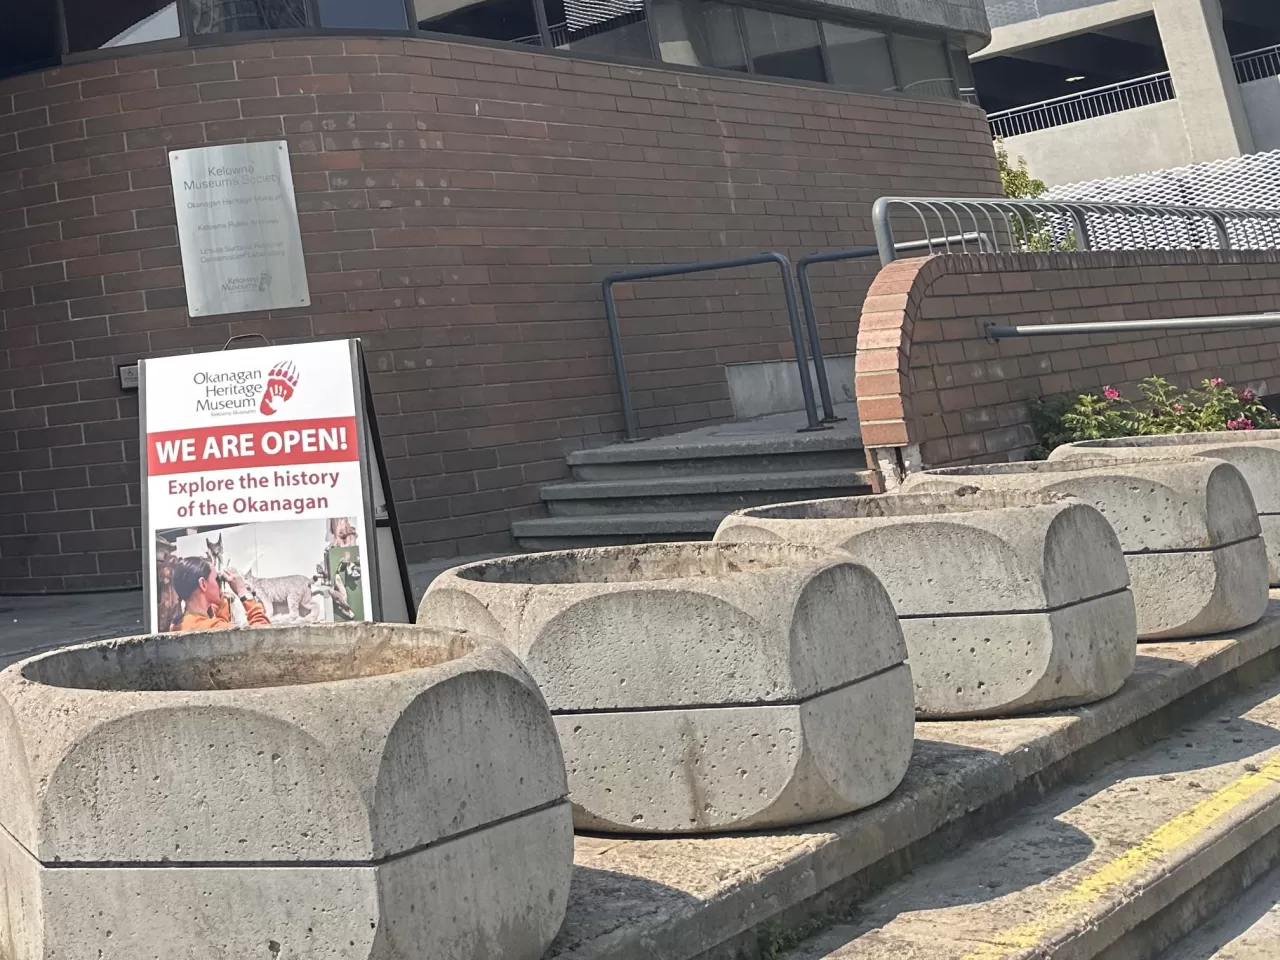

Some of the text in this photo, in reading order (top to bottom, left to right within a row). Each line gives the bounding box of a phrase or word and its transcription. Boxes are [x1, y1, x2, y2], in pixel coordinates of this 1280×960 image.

[207, 165, 255, 177] Kelowna
[183, 174, 281, 191] Museums Society
[193, 368, 262, 386] Okanagan
[205, 381, 263, 398] Heritage
[195, 397, 256, 413] Museum
[155, 426, 348, 464] WE ARE OPEN!
[168, 470, 340, 497] Explore the history
[177, 496, 329, 518] of the Okanagan
